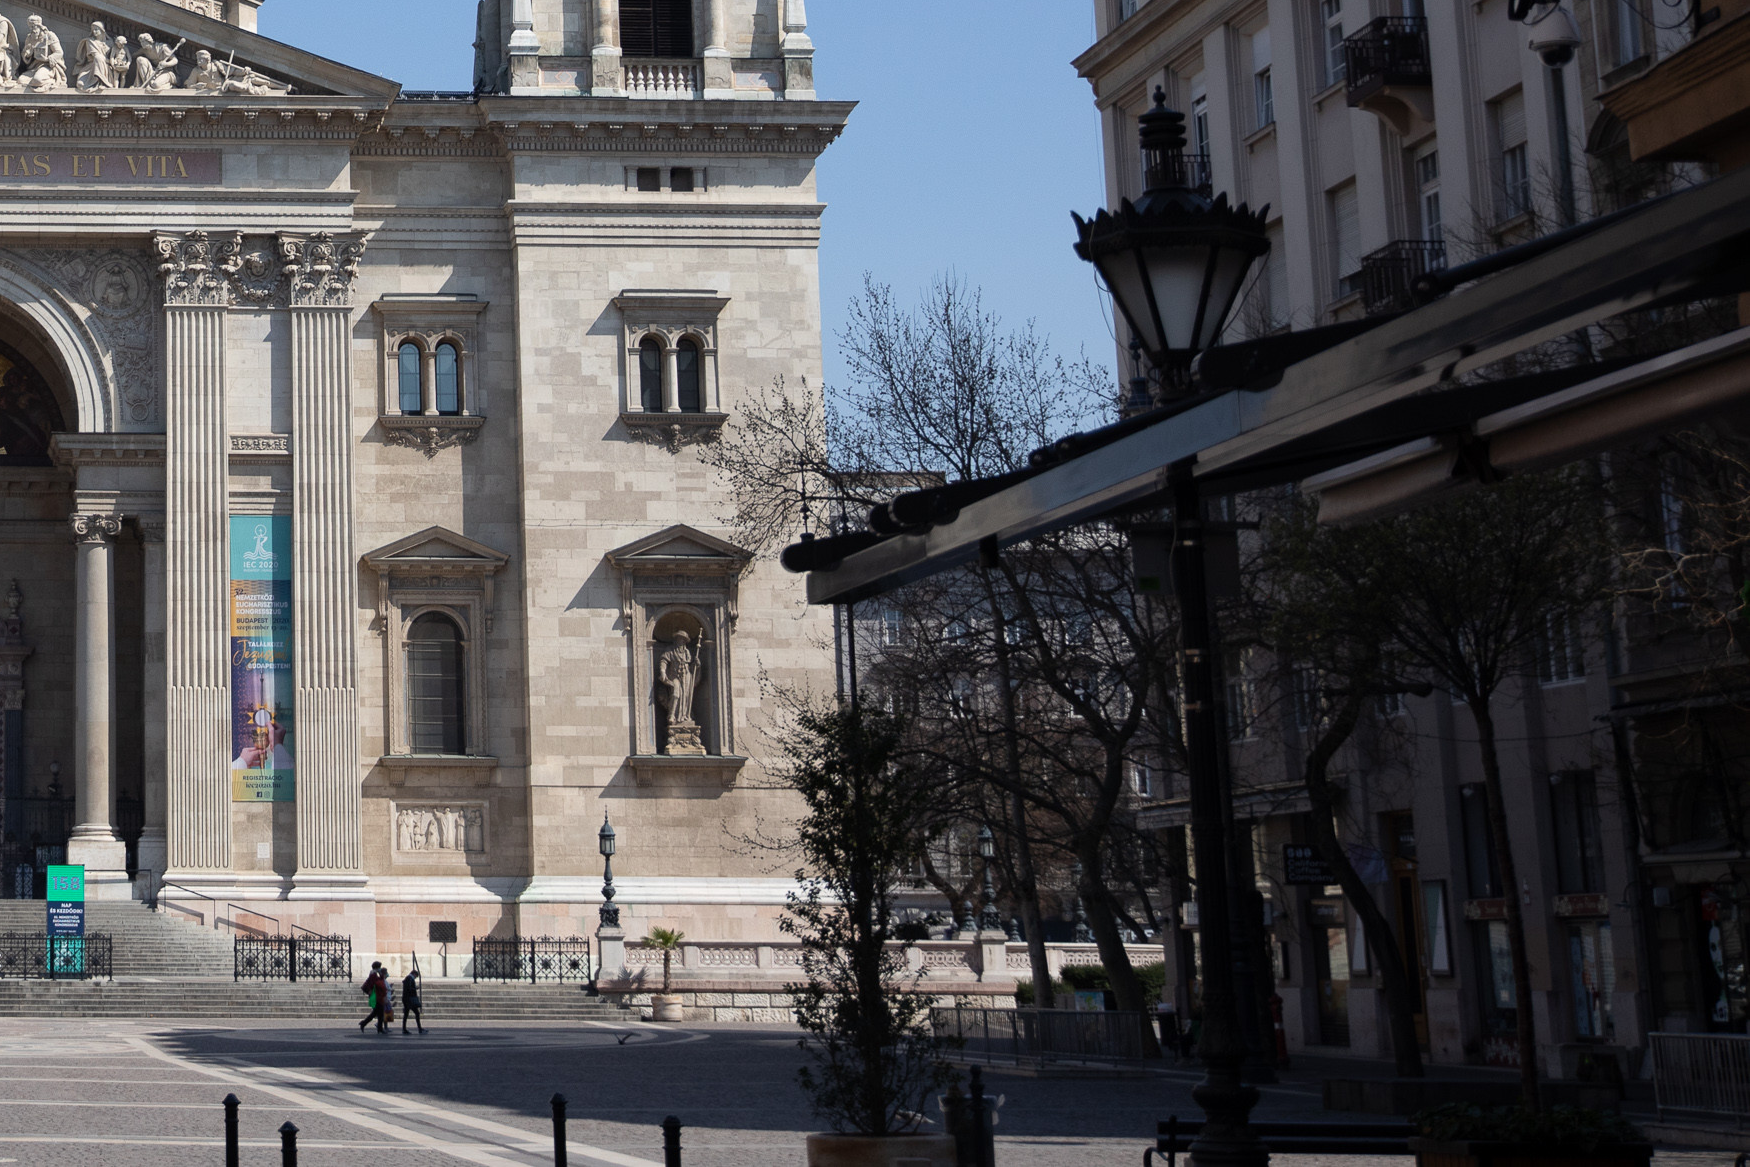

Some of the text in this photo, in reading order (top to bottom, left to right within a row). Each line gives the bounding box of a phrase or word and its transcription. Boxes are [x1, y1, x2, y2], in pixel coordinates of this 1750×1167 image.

[71, 154, 106, 177] ET
[125, 155, 189, 178] VITA
[52, 876, 80, 890] 158
